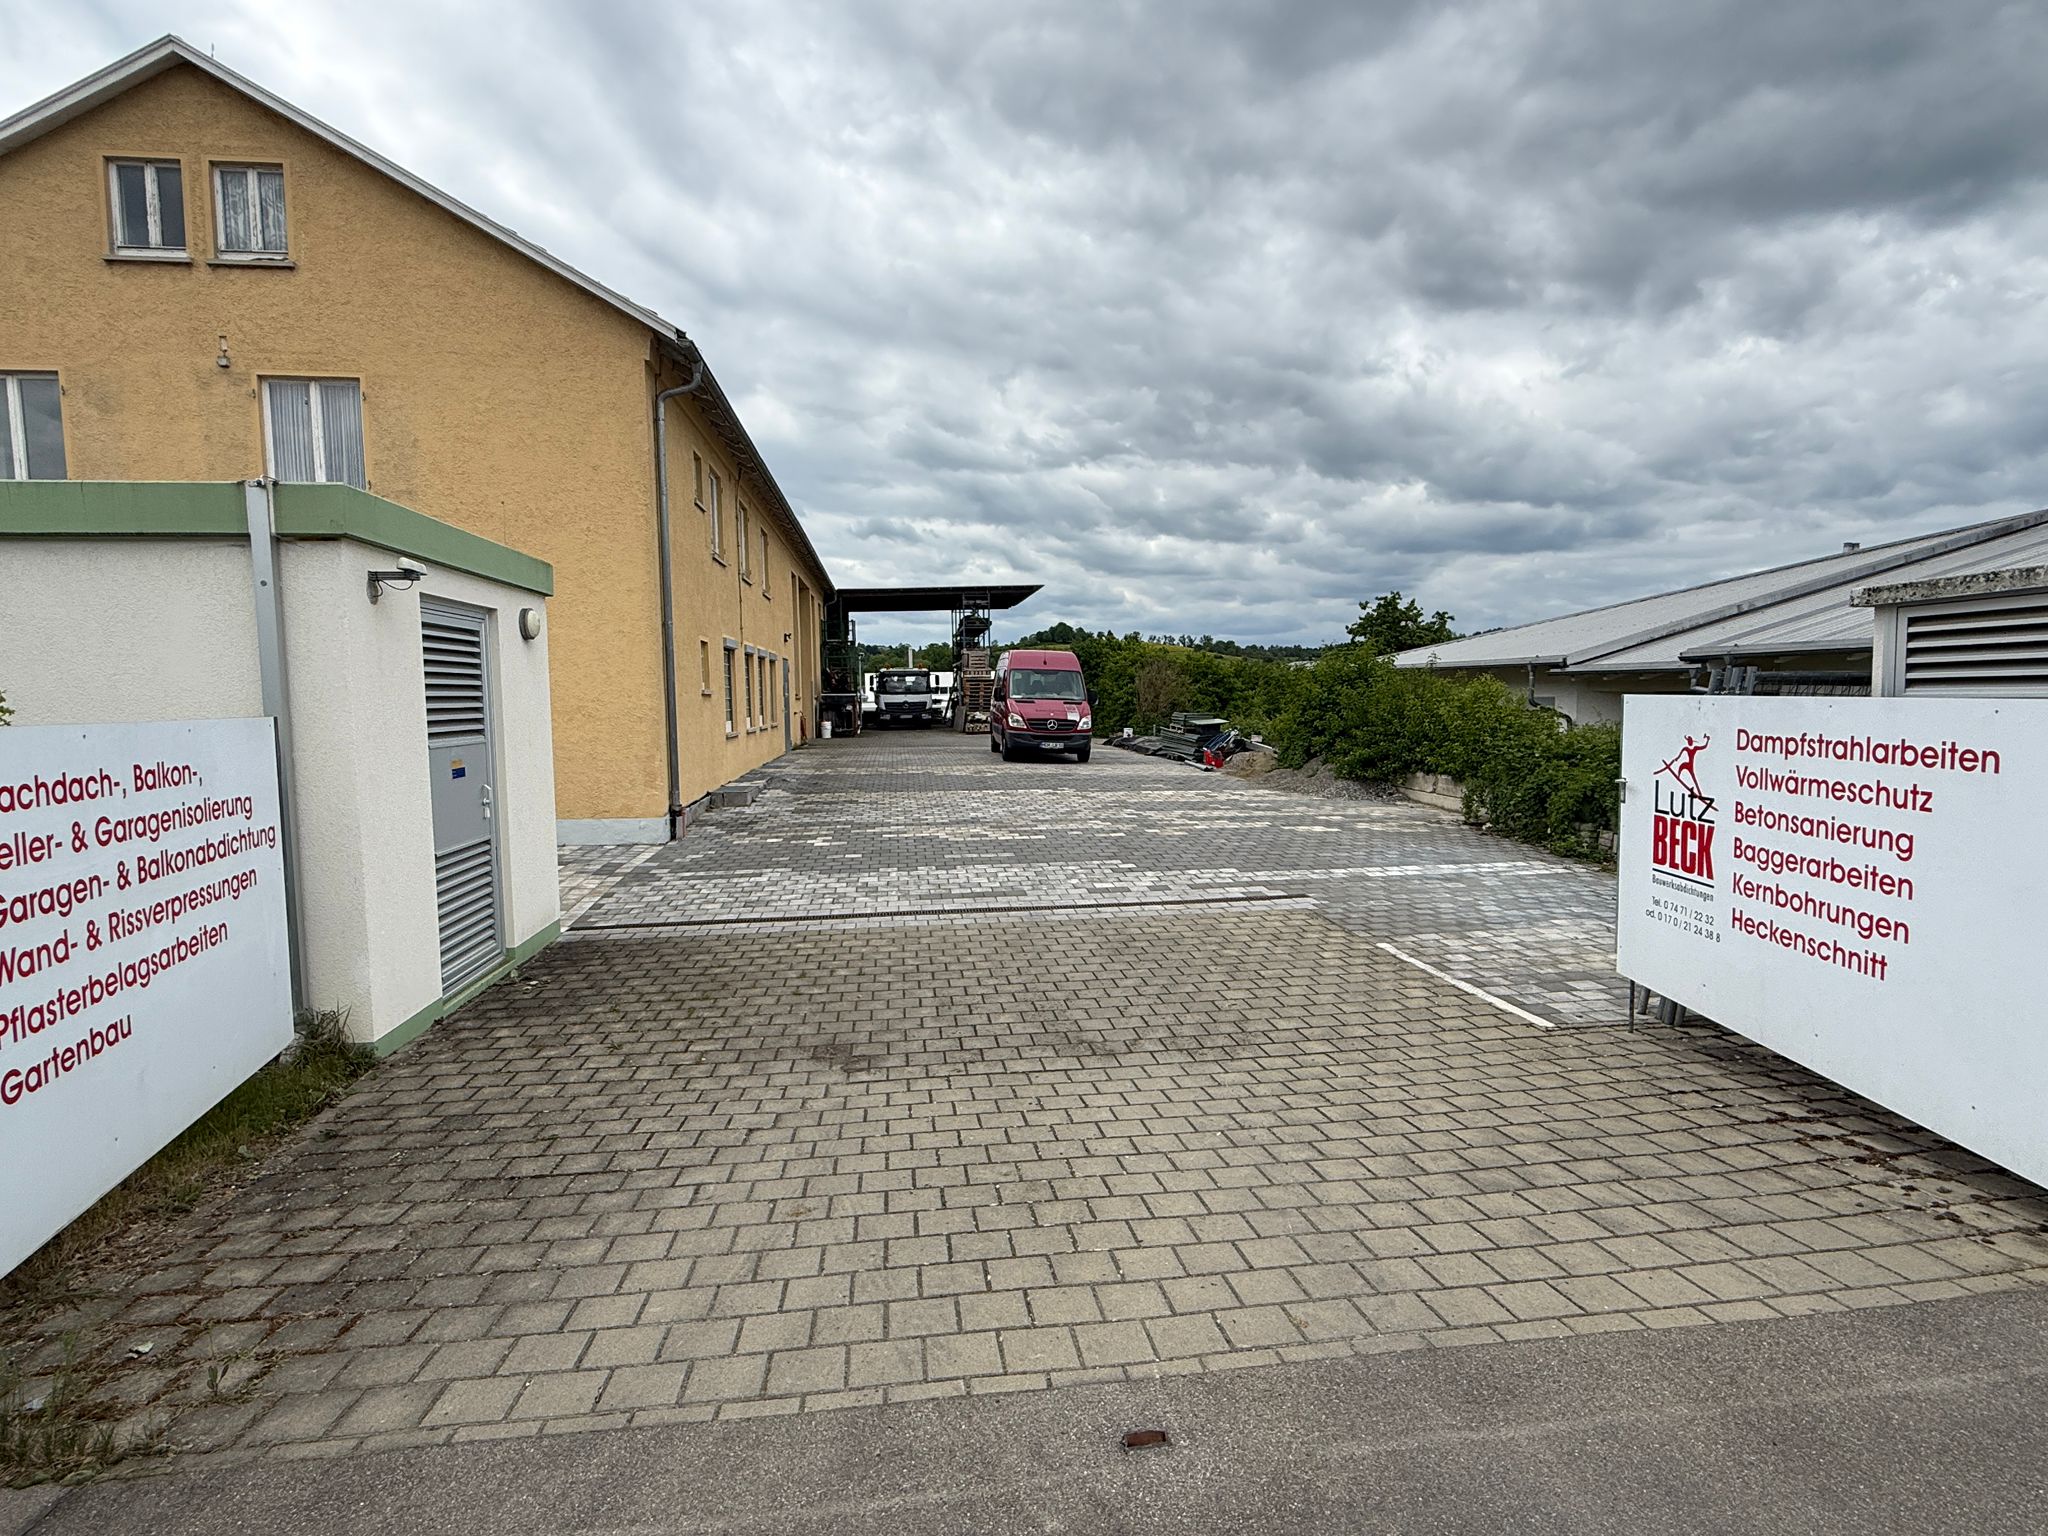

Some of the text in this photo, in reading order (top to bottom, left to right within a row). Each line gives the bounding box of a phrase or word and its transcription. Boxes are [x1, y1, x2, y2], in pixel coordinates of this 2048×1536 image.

[1736, 728, 2000, 775] Dampfstrahlarbeiten
[0, 761, 203, 814] achdach-, Balkon-,
[1654, 779, 1716, 824] Lutz
[1736, 765, 1933, 813] Vollwärmeschutz
[0, 794, 253, 871] eller- & Garagenisolierung
[117, 861, 132, 892] &
[136, 825, 276, 885] Balkonabdichtung
[1652, 814, 1715, 881] BECK
[1734, 801, 1914, 863] Betonsanierung
[1733, 836, 1914, 901] Baggerarbeiten
[86, 919, 103, 952] &
[108, 867, 258, 943] Rissverpressungen
[1732, 873, 1910, 944] Kernbohrungen
[1731, 907, 1889, 981] Heckenschnitt
[0, 920, 228, 1051] Pflasterbelagsarbeiten
[0, 1013, 132, 1106] Gartenbau
